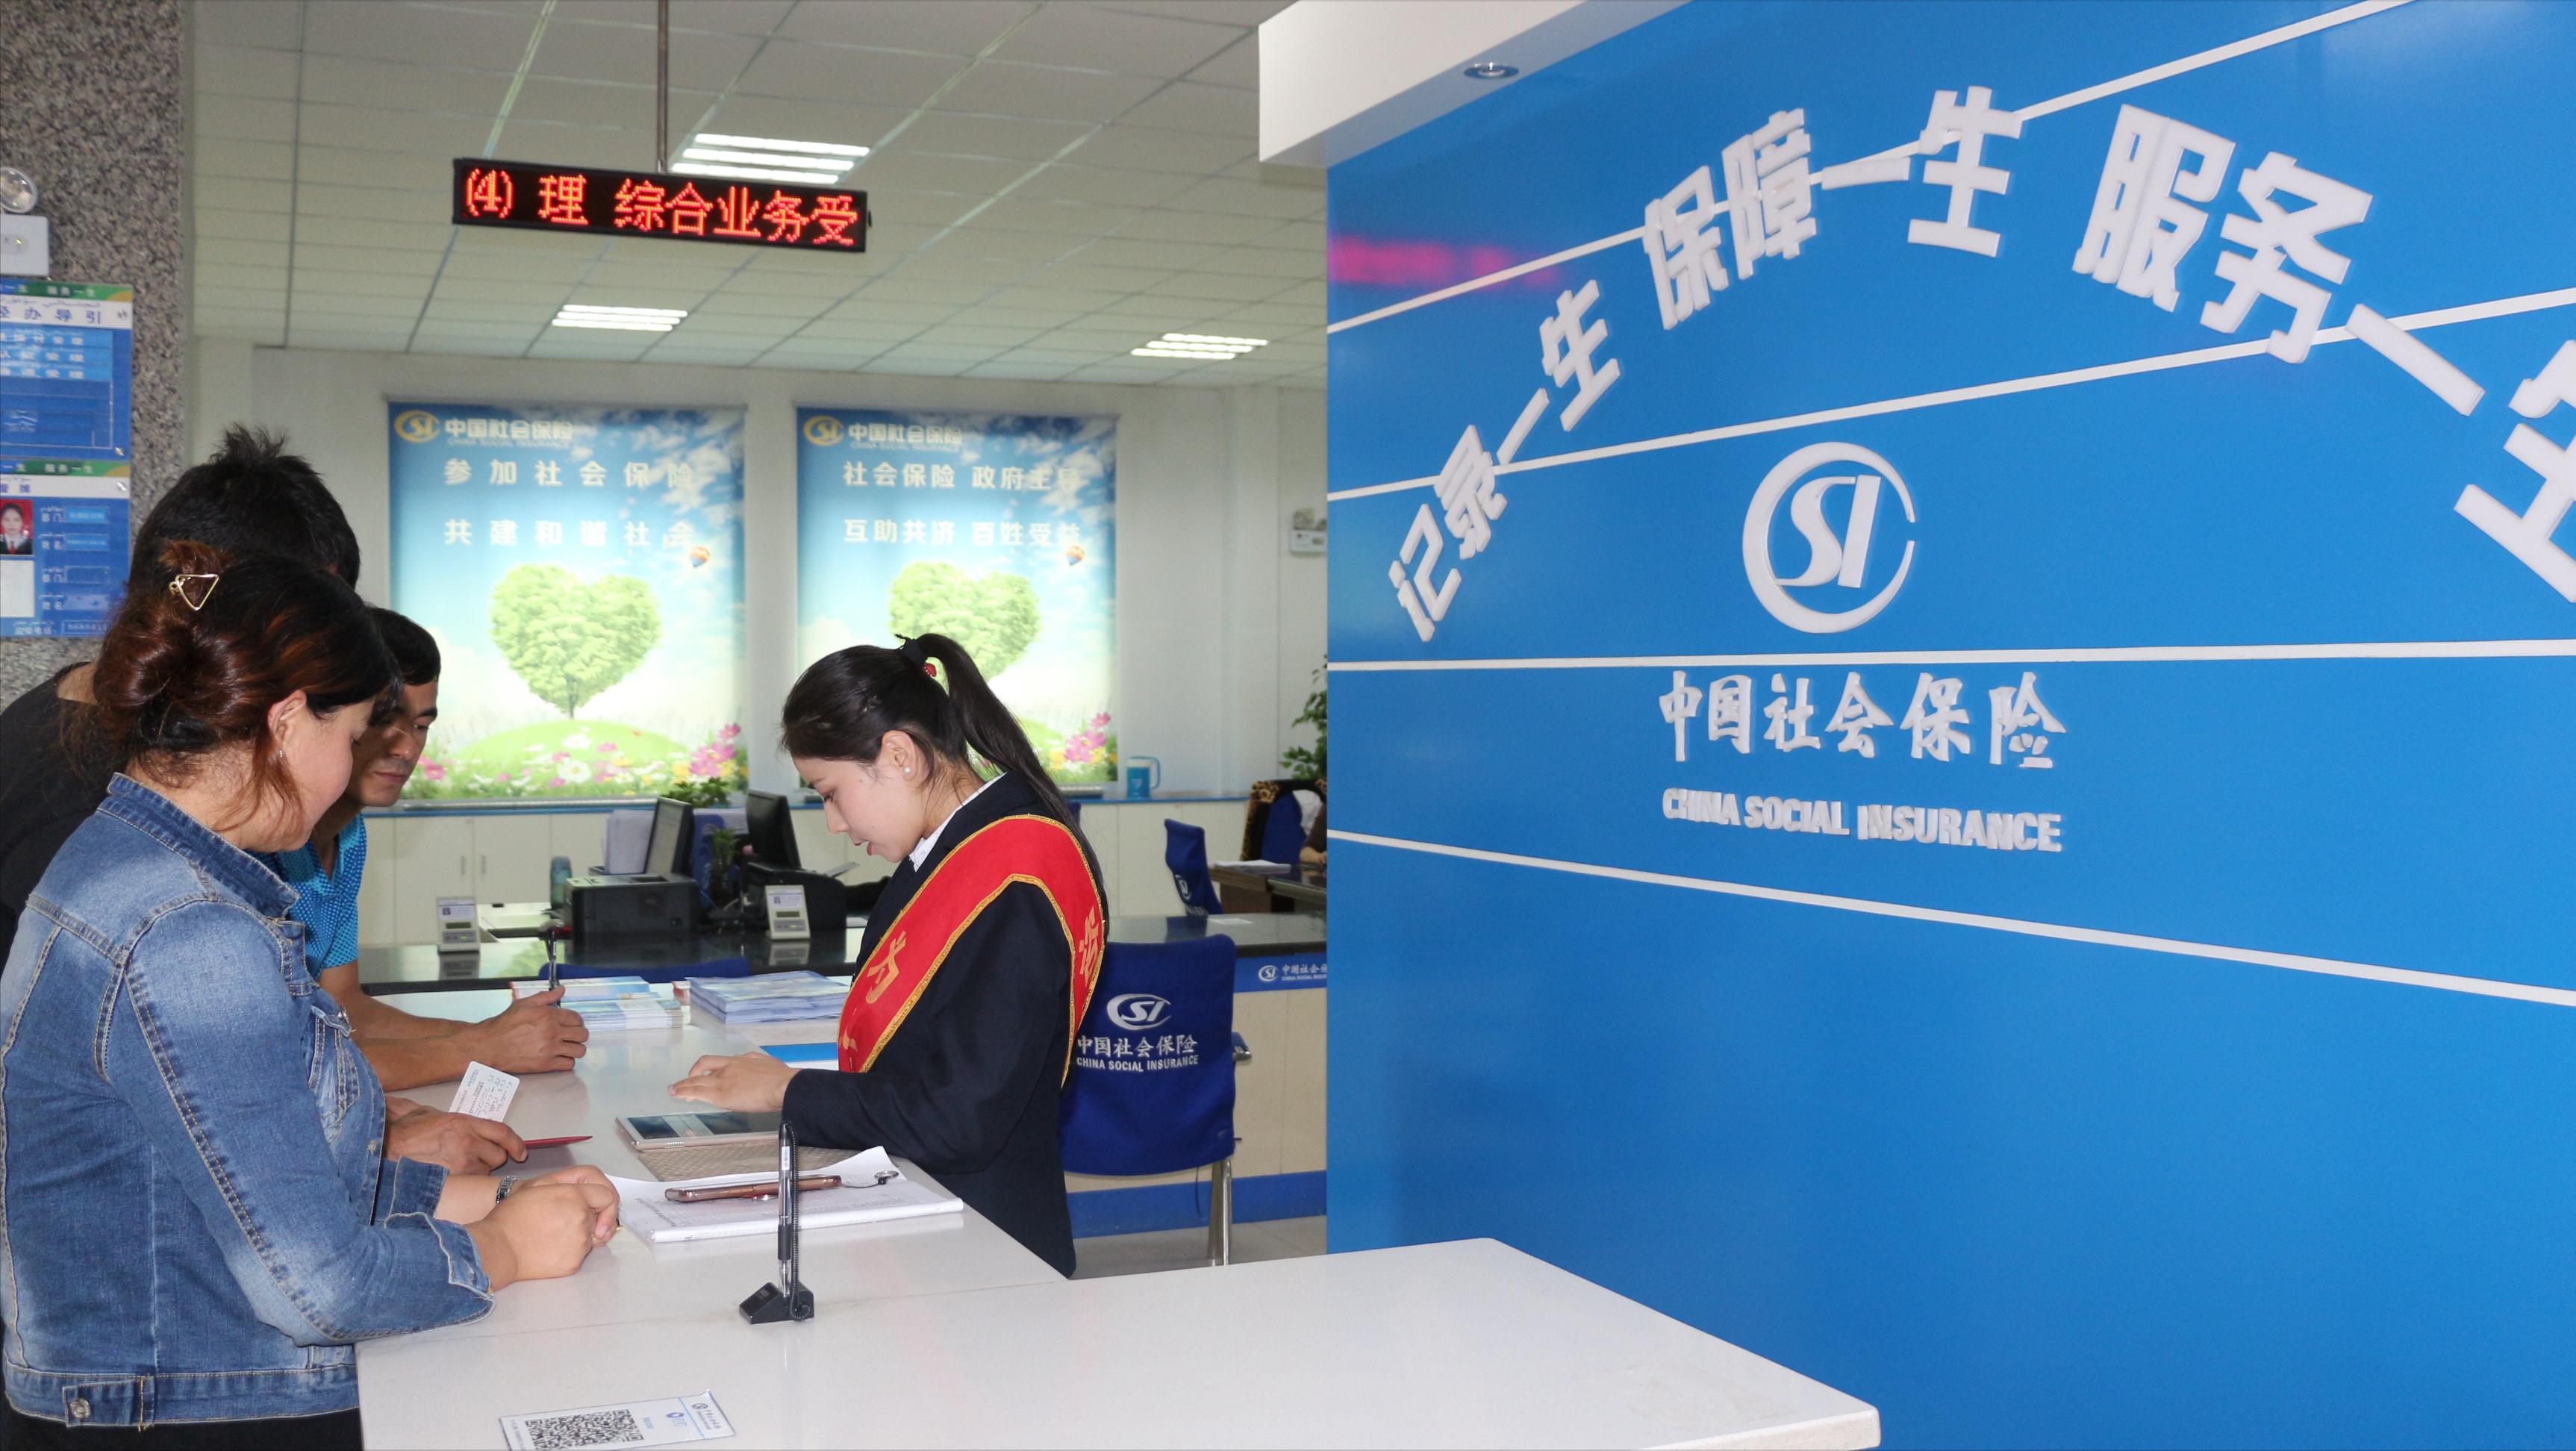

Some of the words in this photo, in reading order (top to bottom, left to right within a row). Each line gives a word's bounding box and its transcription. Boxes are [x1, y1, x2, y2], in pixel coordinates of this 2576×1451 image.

[466, 169, 513, 218] (4)
[538, 174, 588, 225] 理
[614, 178, 859, 245] 综合业务受
[1389, 279, 1621, 642] 记录一生
[1643, 86, 2023, 330] 保障一生
[2071, 104, 2576, 604] 服务一生
[445, 417, 573, 440] 中国社会保险
[848, 422, 962, 444] 中国社会保险
[444, 458, 693, 487] 参加社会保险
[843, 461, 955, 487] 社会保险
[444, 519, 694, 547] 共建和谐社会
[843, 519, 955, 544] 互助共济
[1659, 670, 2067, 768] 中国社会保险
[1662, 787, 1740, 825] CHINA
[1744, 796, 1850, 835] SOCIAL
[1857, 805, 2062, 852] INSURANCE
[1077, 1035, 1197, 1058] 中国社会保险
[1076, 1057, 1105, 1070] CHINA
[1108, 1060, 1144, 1072] SOCIAL
[1147, 1054, 1200, 1070] INSURANCE
